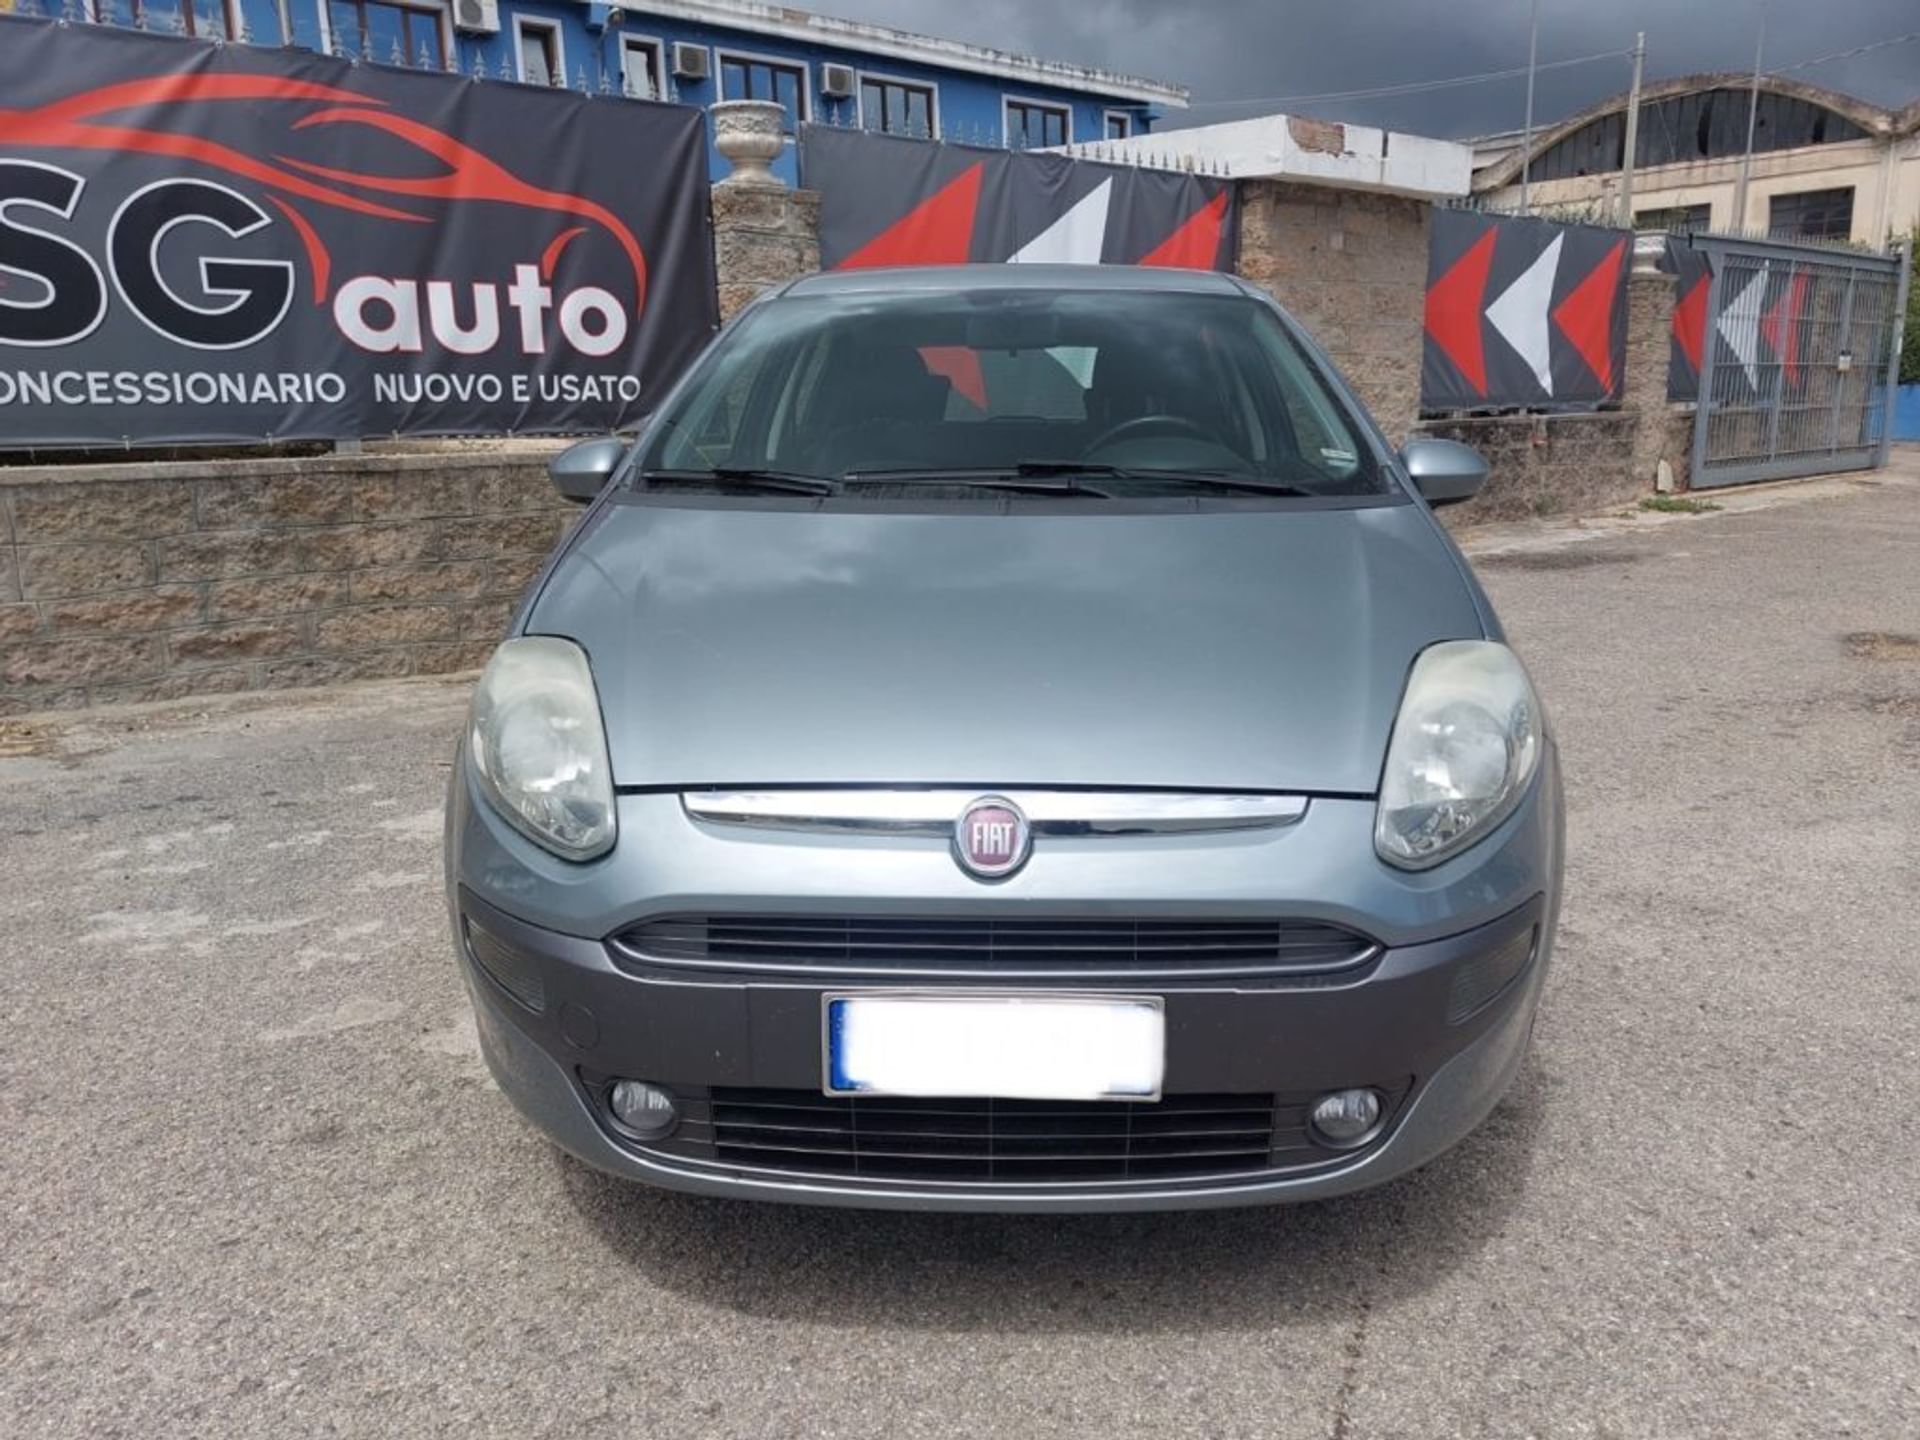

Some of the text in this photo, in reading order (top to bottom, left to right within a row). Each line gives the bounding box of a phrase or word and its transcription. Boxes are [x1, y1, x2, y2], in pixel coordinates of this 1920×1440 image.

[0, 158, 628, 356] SG auto
[374, 373, 502, 402] NUOVO
[511, 375, 530, 401] E
[538, 375, 641, 402] USATO
[972, 822, 1013, 854] FIAT
